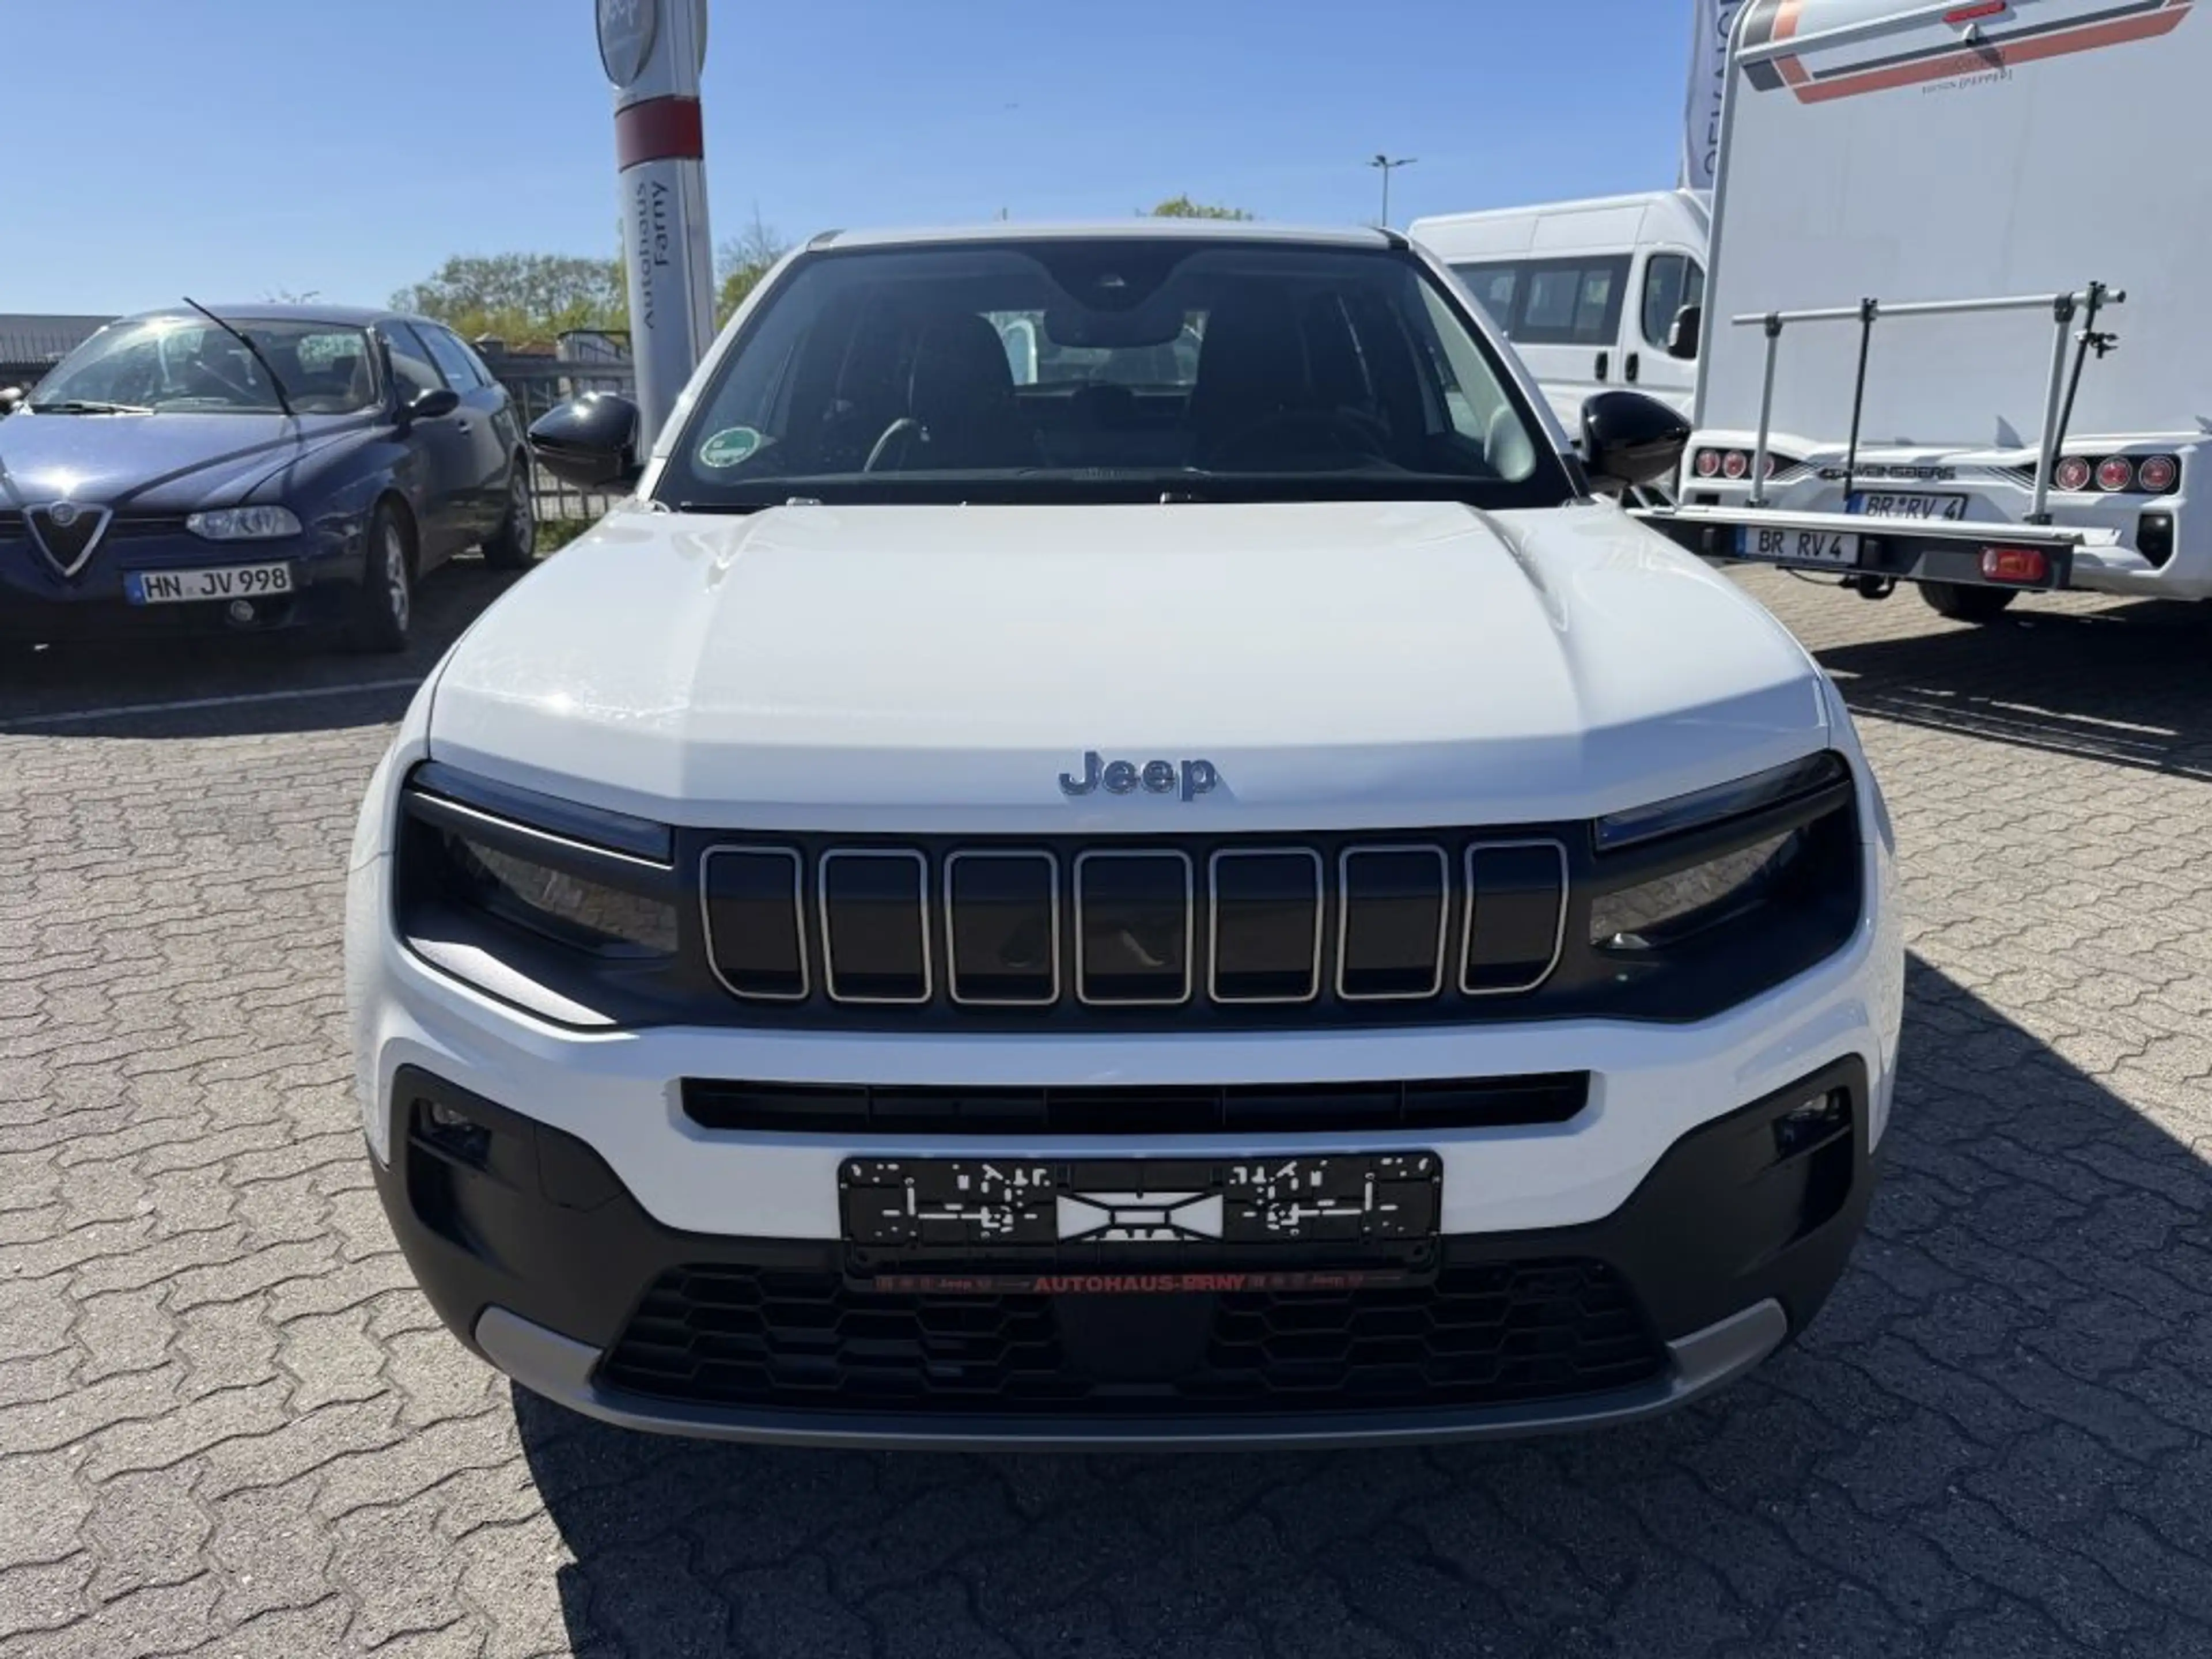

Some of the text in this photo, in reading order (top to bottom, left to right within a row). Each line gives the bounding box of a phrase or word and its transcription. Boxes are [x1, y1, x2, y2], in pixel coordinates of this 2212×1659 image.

[652, 180, 669, 266] Farny
[637, 182, 655, 329] Autohaus
[1866, 497, 1957, 520] BR RV 4
[1759, 530, 1842, 559] BR RV 4
[145, 567, 287, 597] HN JV 998
[1058, 751, 1217, 802] Jeep
